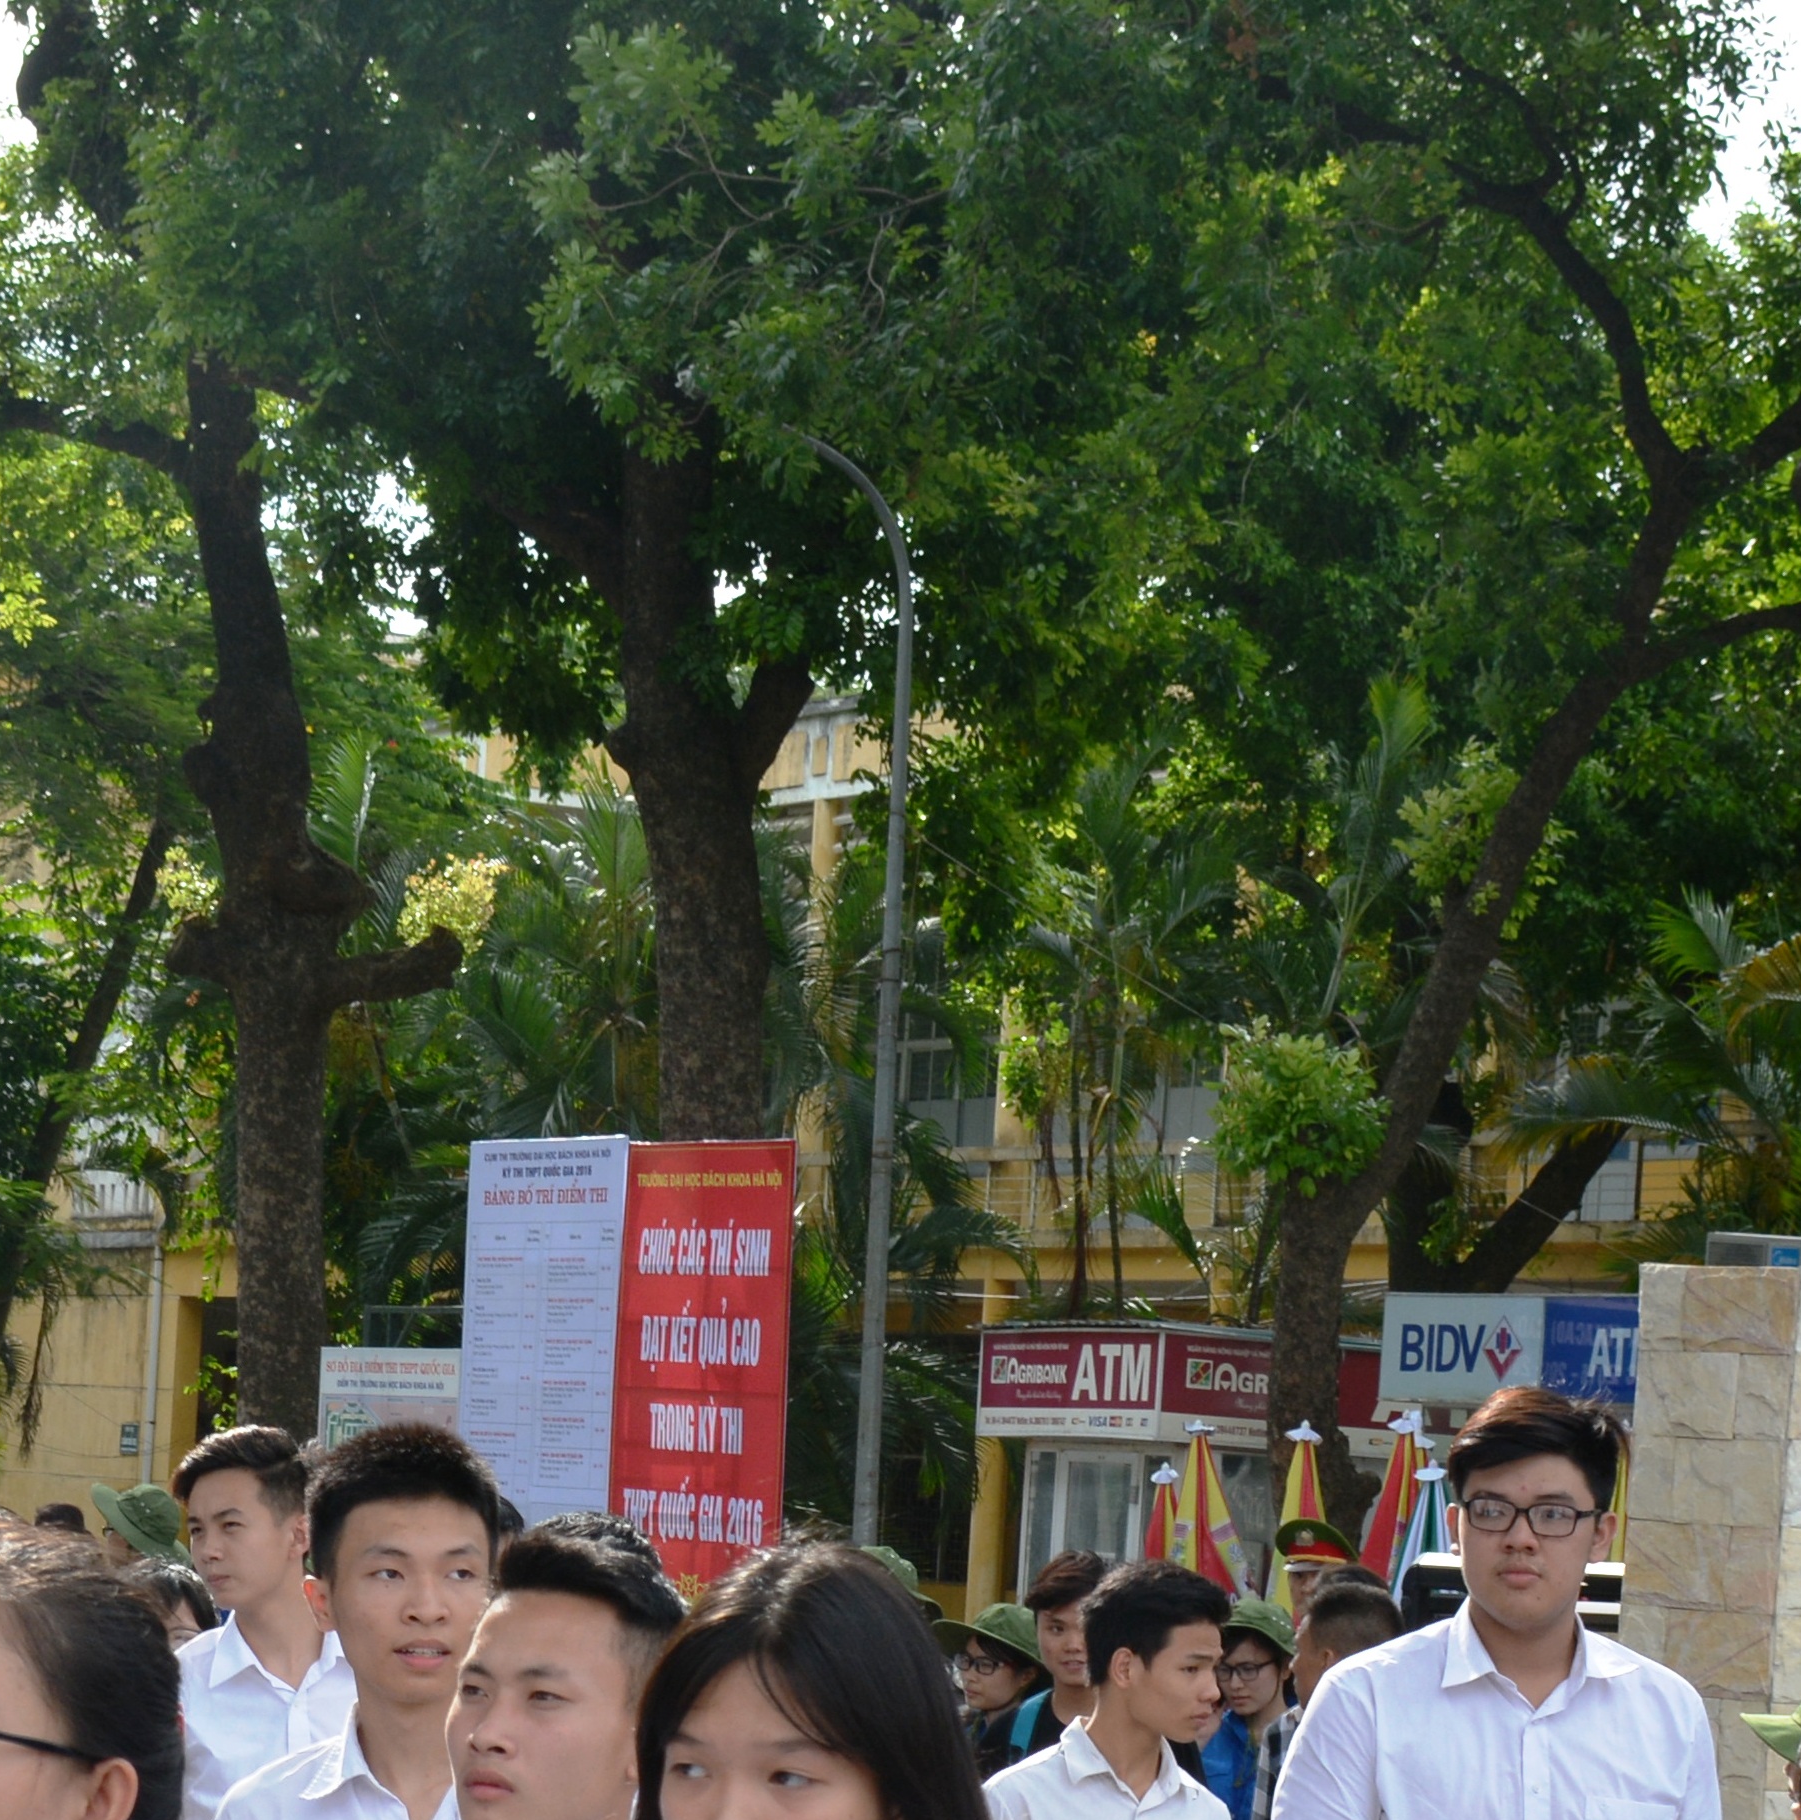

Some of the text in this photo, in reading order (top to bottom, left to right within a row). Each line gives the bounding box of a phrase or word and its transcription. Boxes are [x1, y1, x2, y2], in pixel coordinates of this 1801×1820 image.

[484, 1184, 515, 1206] BẢNG
[557, 1178, 587, 1204] ĐIỂM
[589, 1187, 608, 1203] THI
[638, 1169, 669, 1187] TRƯỜNG
[702, 1169, 725, 1187] BÁCH
[727, 1173, 751, 1187] KHOA
[752, 1169, 765, 1187] HÀ
[638, 1217, 772, 1277] CHÚC CÁC THÍ SINH
[640, 1297, 761, 1373] ĐẠT KẾT QUẢ CAO
[1400, 1323, 1486, 1373] BIDV
[1588, 1327, 1638, 1377] AT
[1007, 1357, 1067, 1384] AGRIBANK
[1071, 1343, 1151, 1402] ATM
[650, 1395, 743, 1455] TRONG KỲ THI
[623, 1476, 764, 1546] THPT QUỐC GIA 2016
